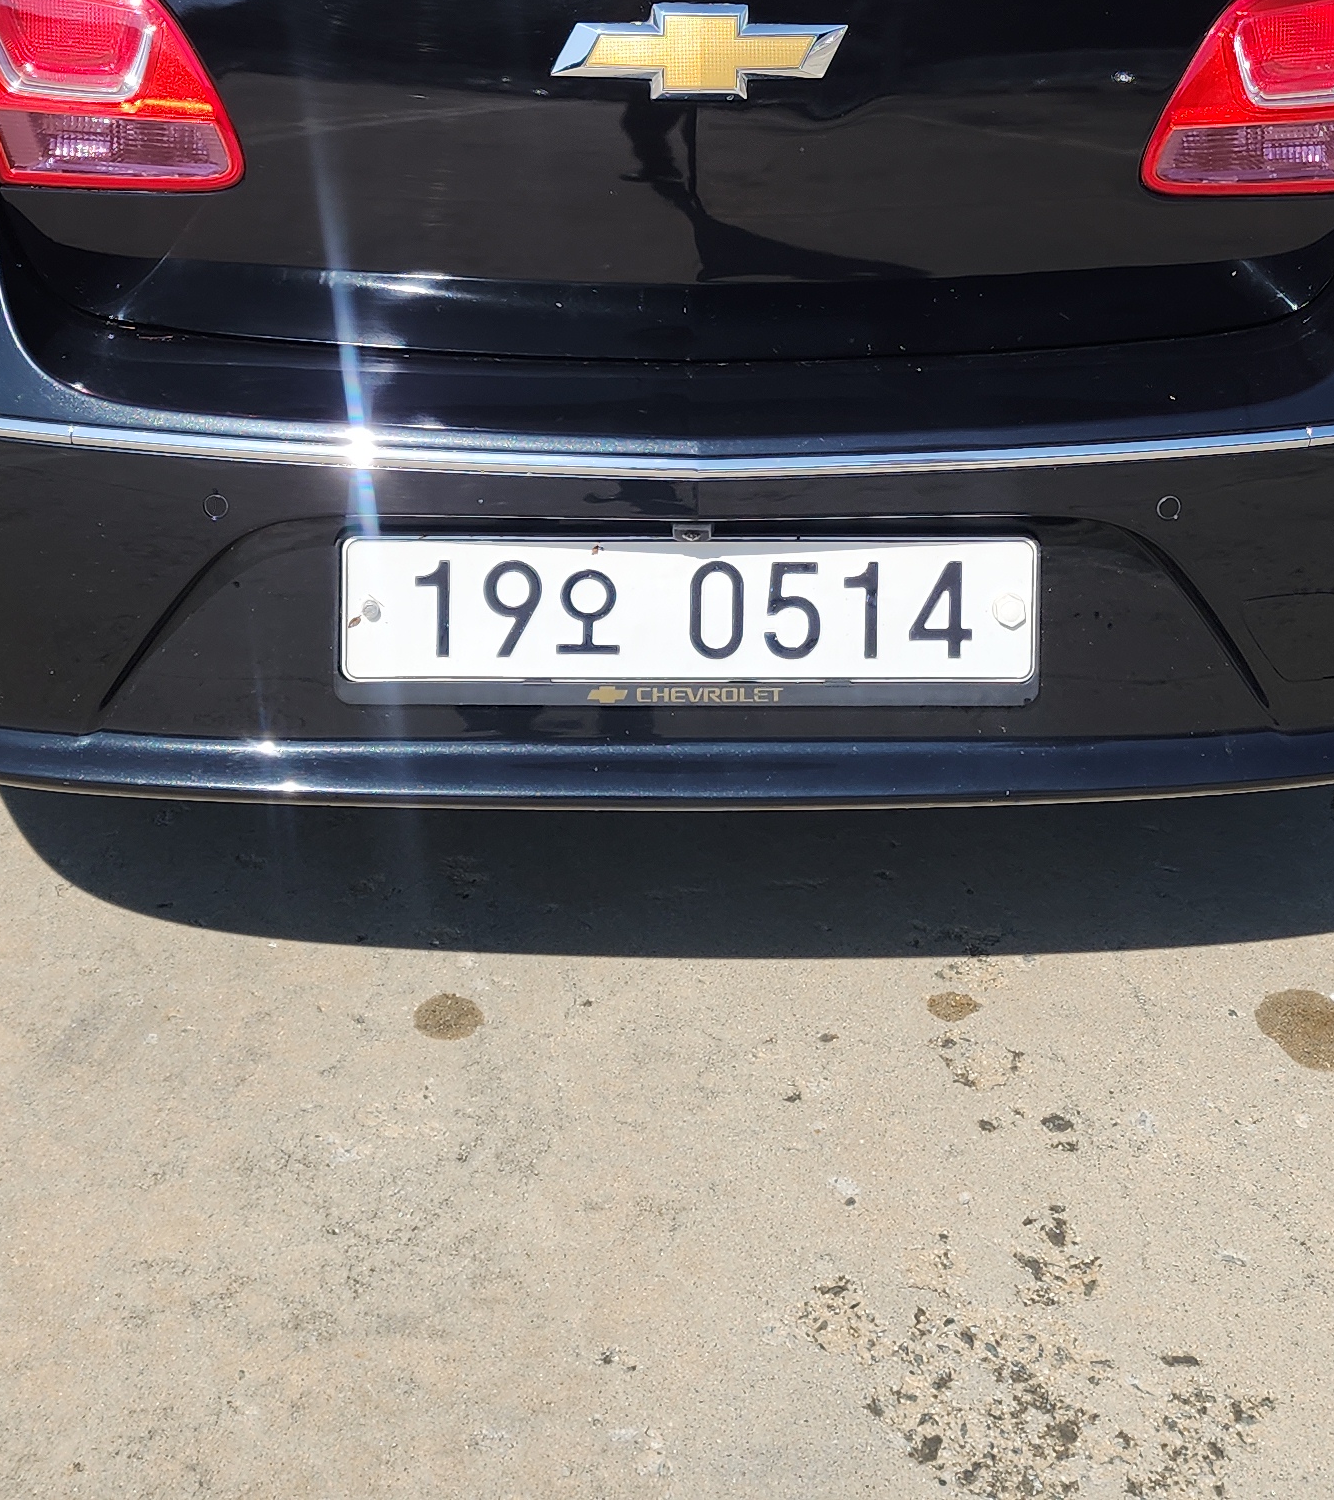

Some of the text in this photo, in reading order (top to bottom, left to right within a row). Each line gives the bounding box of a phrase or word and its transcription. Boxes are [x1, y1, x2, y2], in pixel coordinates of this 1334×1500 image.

[414, 559, 973, 661] 19오 0514
[635, 686, 784, 704] CHEVROLET
